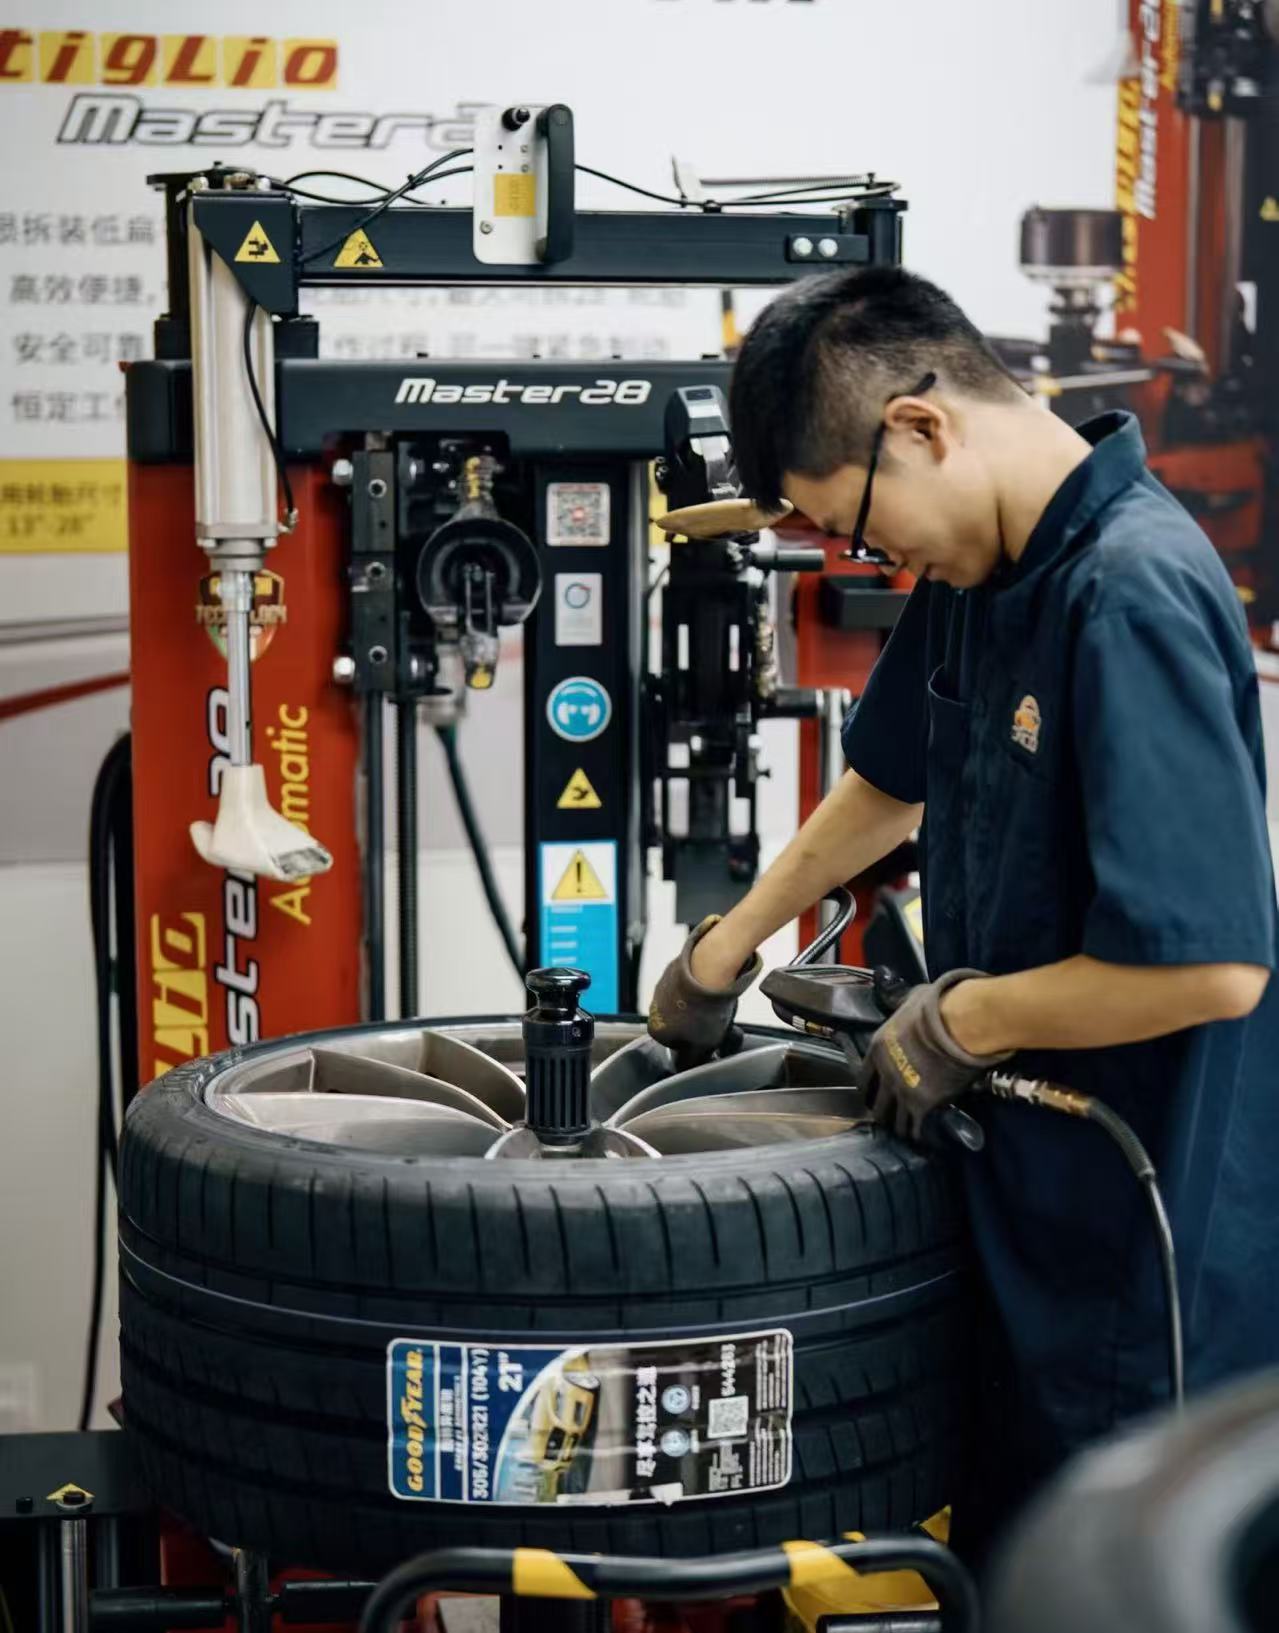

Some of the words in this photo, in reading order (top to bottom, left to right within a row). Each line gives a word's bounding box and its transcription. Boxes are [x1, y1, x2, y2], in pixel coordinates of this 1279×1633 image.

[12, 391, 126, 422] 恒定工
[395, 378, 652, 404] Master28
[265, 704, 312, 925] Amatic
[400, 1350, 428, 1492] GOODYEAR
